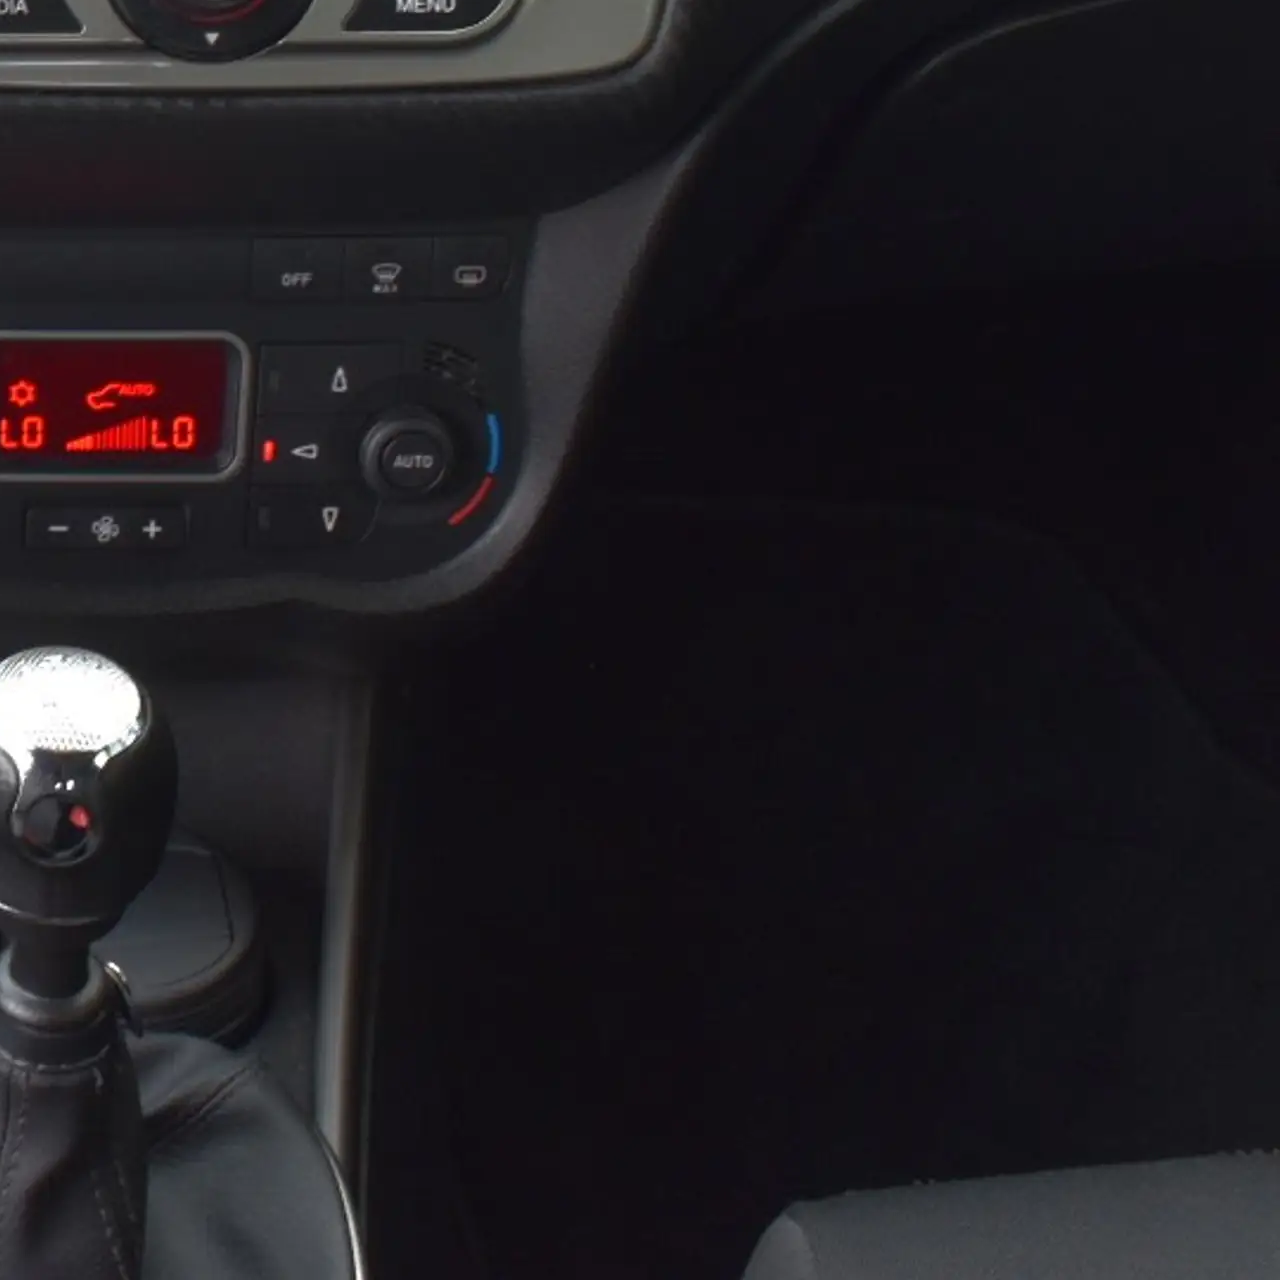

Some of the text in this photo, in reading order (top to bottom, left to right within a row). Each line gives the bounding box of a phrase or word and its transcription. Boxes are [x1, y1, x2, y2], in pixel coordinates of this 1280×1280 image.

[281, 273, 312, 287] OFF
[118, 383, 156, 396] AUTO
[393, 455, 434, 468] AUTO
